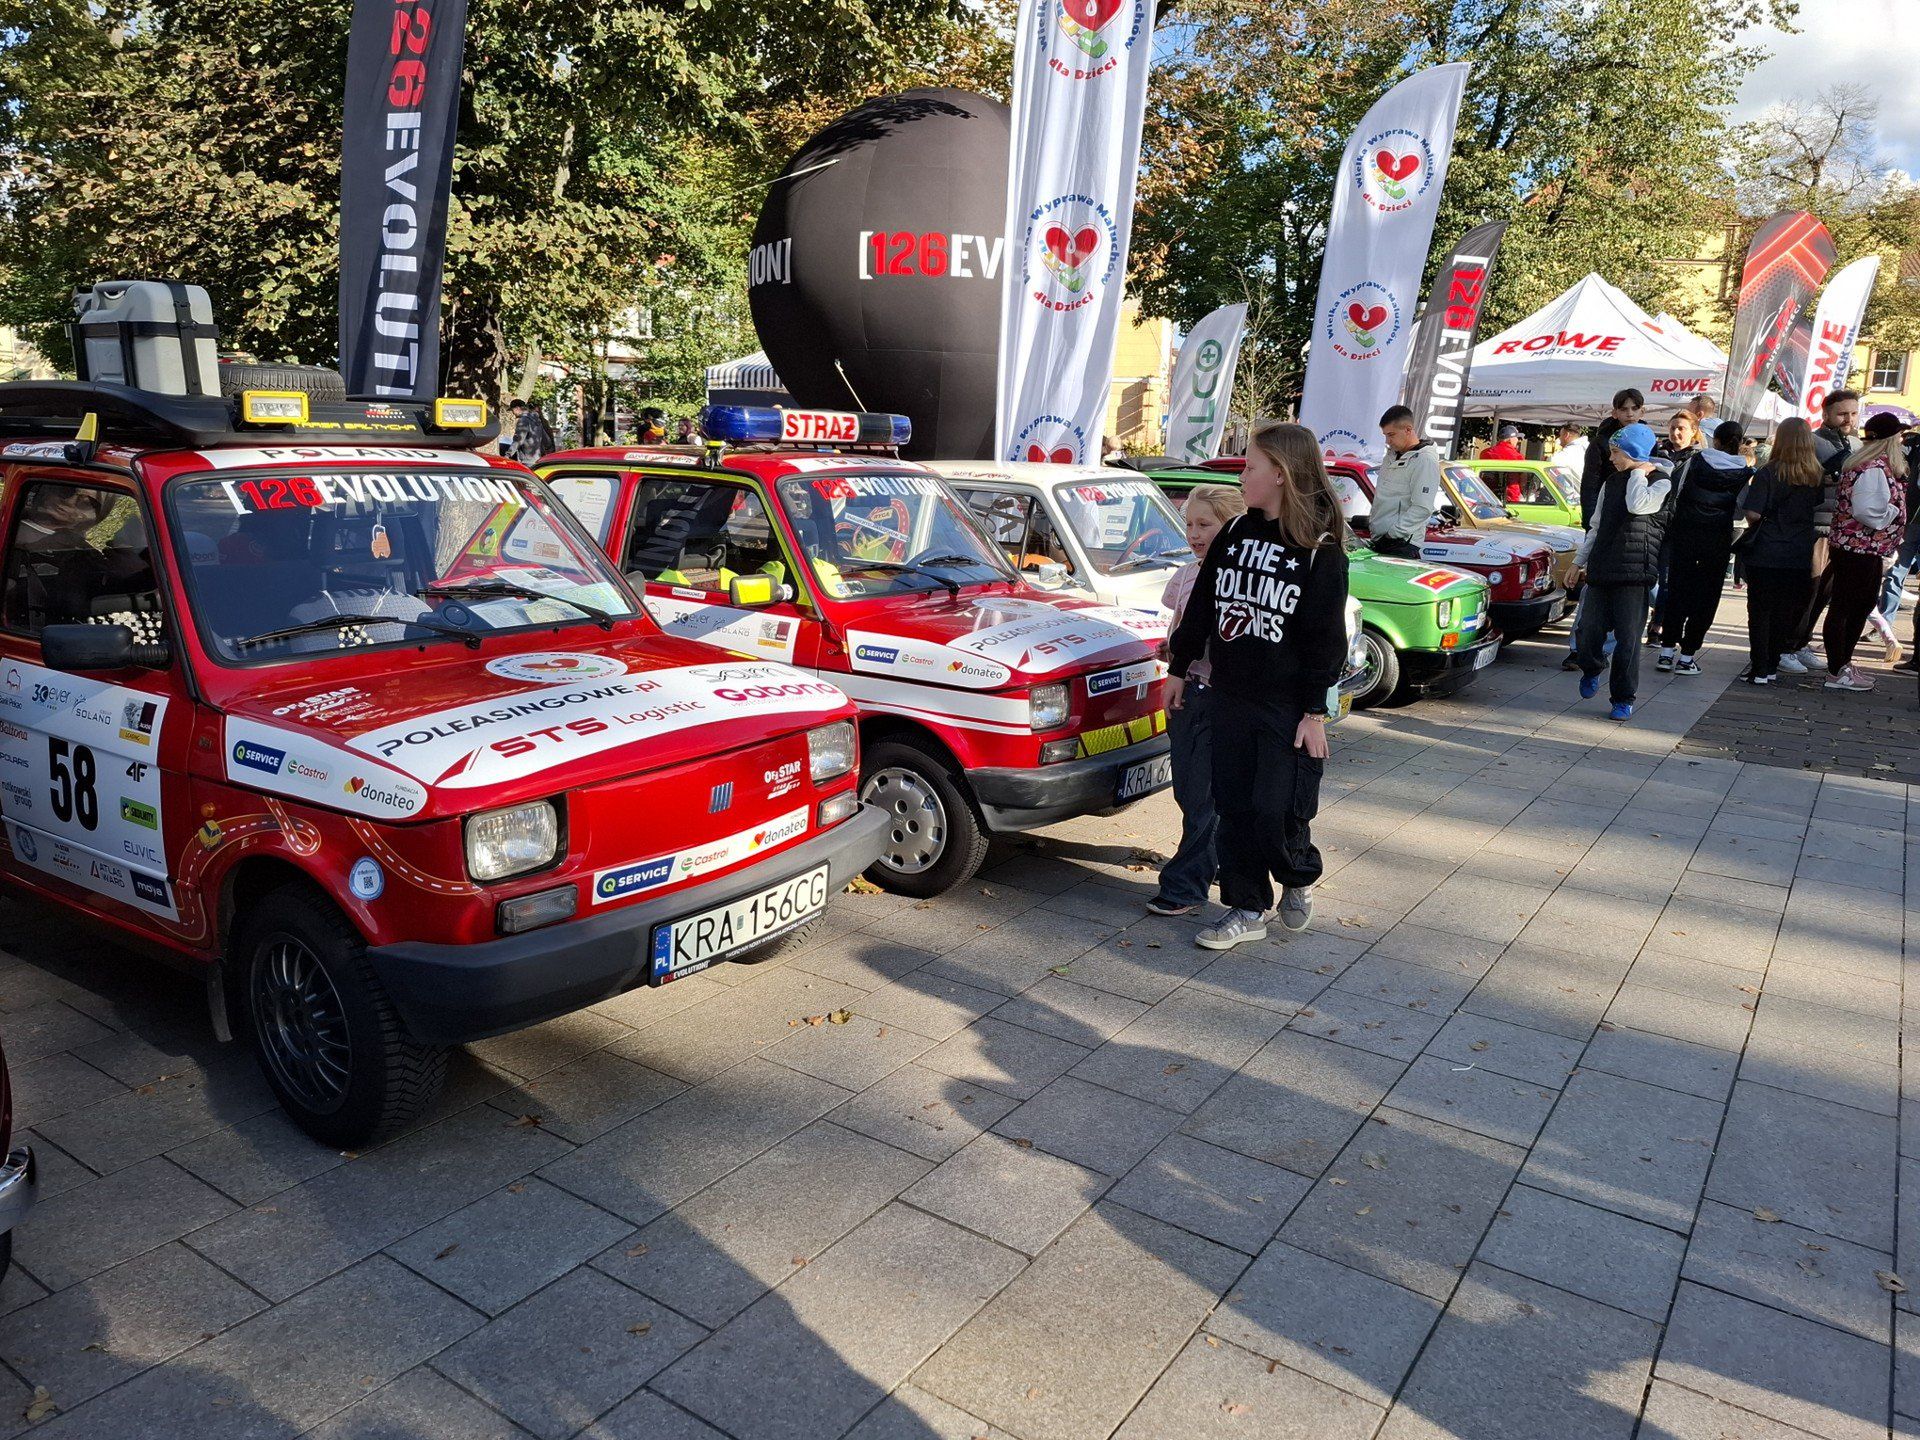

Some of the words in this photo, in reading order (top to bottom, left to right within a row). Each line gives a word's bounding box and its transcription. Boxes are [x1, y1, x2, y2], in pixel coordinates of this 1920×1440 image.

[1049, 58, 1070, 77] dla
[1075, 56, 1118, 80] Dzieci
[1354, 148, 1368, 189] Wielka
[1367, 129, 1420, 147] Wyprawa
[1030, 193, 1094, 221] Wyprawa
[1378, 199, 1412, 212] Dzieci
[1033, 291, 1052, 309] dla
[1054, 291, 1094, 312] Dzieci
[1326, 301, 1341, 340] Wielka
[1339, 280, 1387, 299] Wyprawa
[1333, 343, 1348, 357] dla
[1350, 348, 1382, 361] Dzieci
[1493, 331, 1626, 355] ROWE
[1650, 378, 1711, 392] ROWE
[260, 448, 440, 460] POLAND
[220, 474, 528, 515] [126EVOLUTION]
[1237, 538, 1286, 573] THE
[866, 649, 895, 660] SERVICE
[1034, 634, 1087, 655] STS
[909, 655, 934, 666] Castrol
[961, 664, 1003, 680] donateo
[1097, 675, 1121, 687] SERVICE
[713, 683, 839, 701] Gabona
[75, 708, 112, 725] SOLANO
[376, 680, 662, 758] POLEASINGOWE.pl
[489, 717, 609, 759] STS
[612, 699, 706, 726] Logistic
[245, 749, 280, 767] SERVICE
[125, 761, 148, 783] 4F
[297, 763, 328, 781] Castrol
[1125, 763, 1153, 796] KRA
[48, 736, 98, 831] 58
[360, 786, 415, 812] donateo
[764, 818, 807, 845] donateo
[693, 847, 729, 867] Castrol
[617, 864, 669, 888] SERVICE
[673, 909, 735, 966] KRA
[748, 871, 826, 935] 156CG
[655, 957, 668, 970] PL
